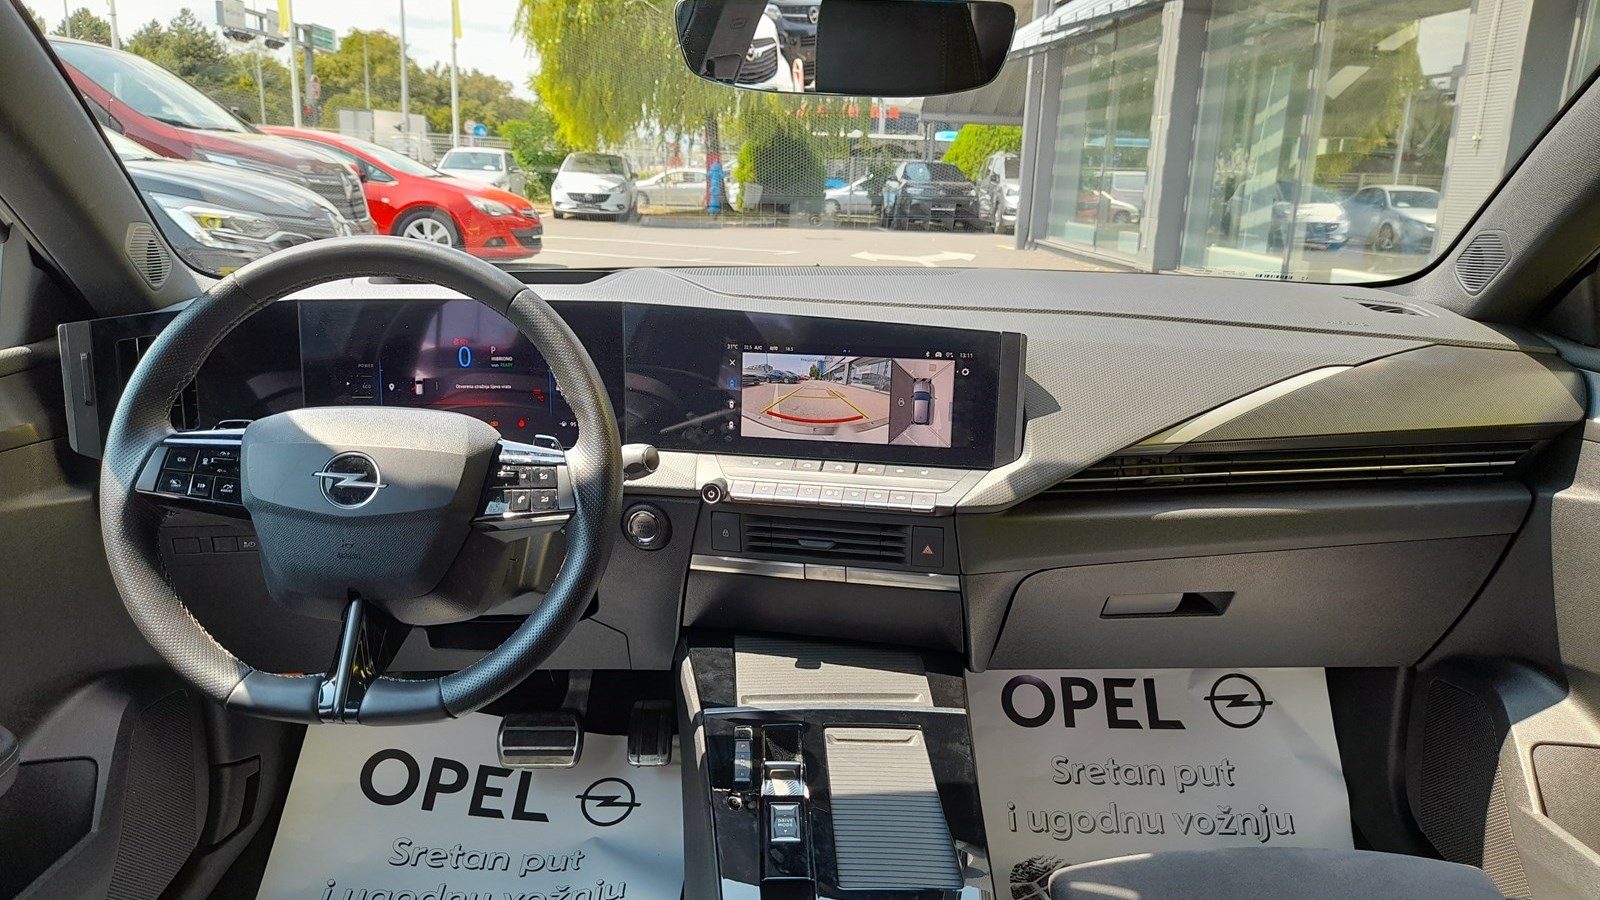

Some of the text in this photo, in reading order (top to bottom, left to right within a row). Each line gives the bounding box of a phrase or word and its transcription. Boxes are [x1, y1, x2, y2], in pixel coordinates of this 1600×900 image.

[458, 346, 471, 367] 0
[490, 346, 496, 354] P
[1001, 674, 1187, 730] OPEL
[359, 748, 549, 822] OPEL
[1050, 754, 1236, 793] Sretan put
[1006, 800, 1296, 843] i ugodnu vožnju
[388, 837, 586, 878] Sretan put
